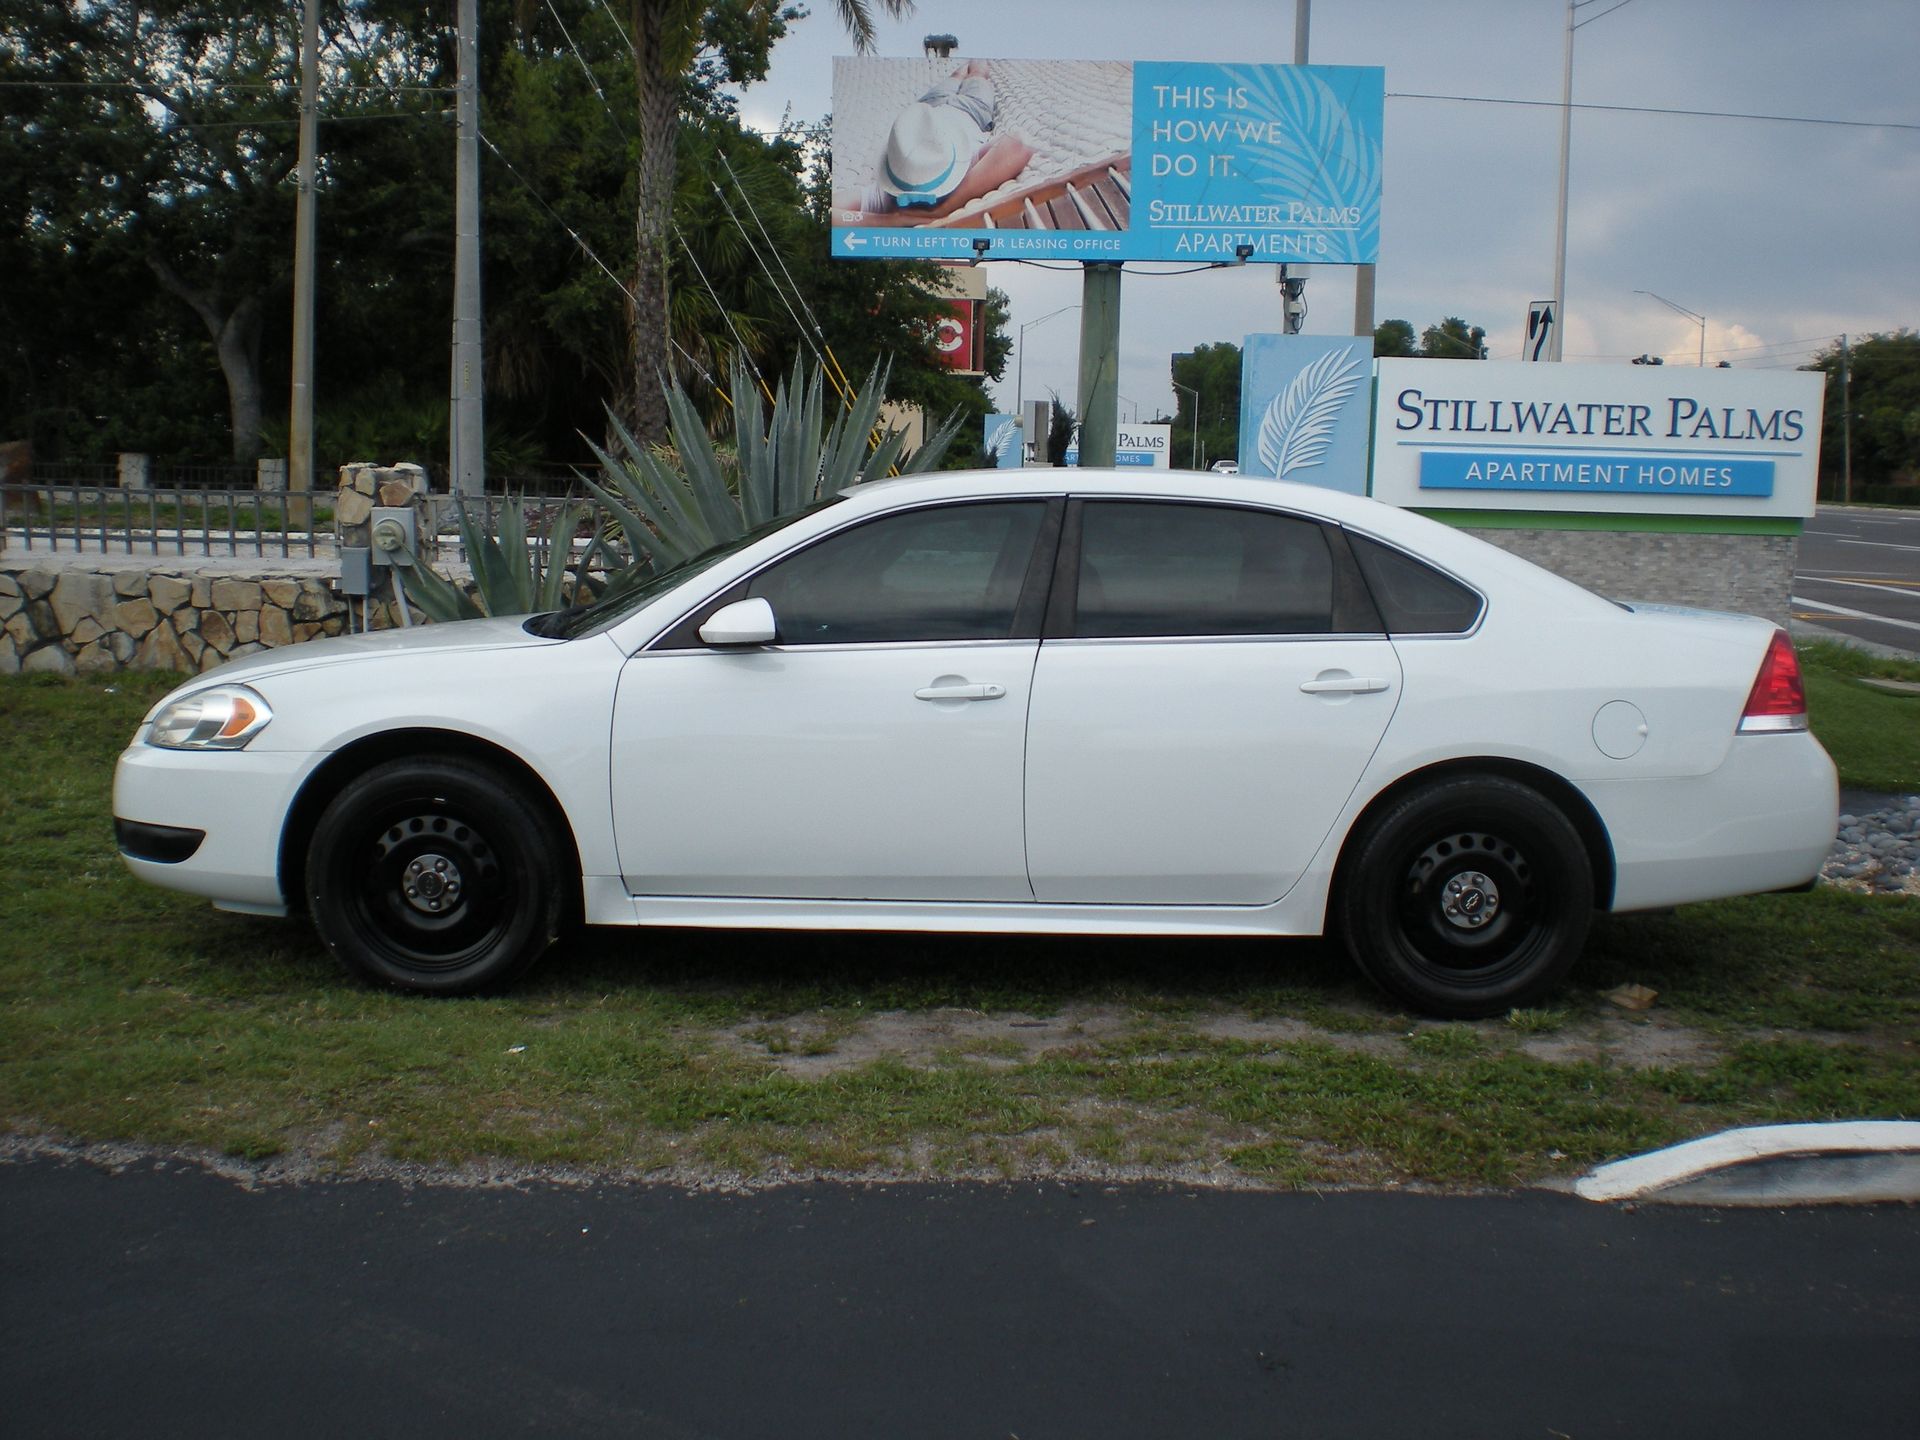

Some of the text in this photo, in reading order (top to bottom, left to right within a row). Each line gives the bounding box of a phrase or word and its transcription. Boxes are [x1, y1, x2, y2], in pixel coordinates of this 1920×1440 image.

[1152, 85, 1249, 109] THIS IS
[1152, 120, 1282, 144] HOW WE
[1152, 153, 1239, 177] DO IT.
[1149, 199, 1361, 225] STILLWATER PALMS
[872, 236, 911, 248] TURN
[916, 237, 947, 248] LEFT
[952, 236, 970, 248] TO
[1011, 238, 1068, 249] LEASING
[1073, 239, 1121, 251] OFFICE
[1175, 232, 1328, 255] APARTMENTS
[1396, 388, 1804, 442] STILLWATER PALMS
[1118, 433, 1164, 448] PALMS
[1115, 454, 1141, 463] OMES
[1465, 461, 1733, 487] APARTMENT HOMES
